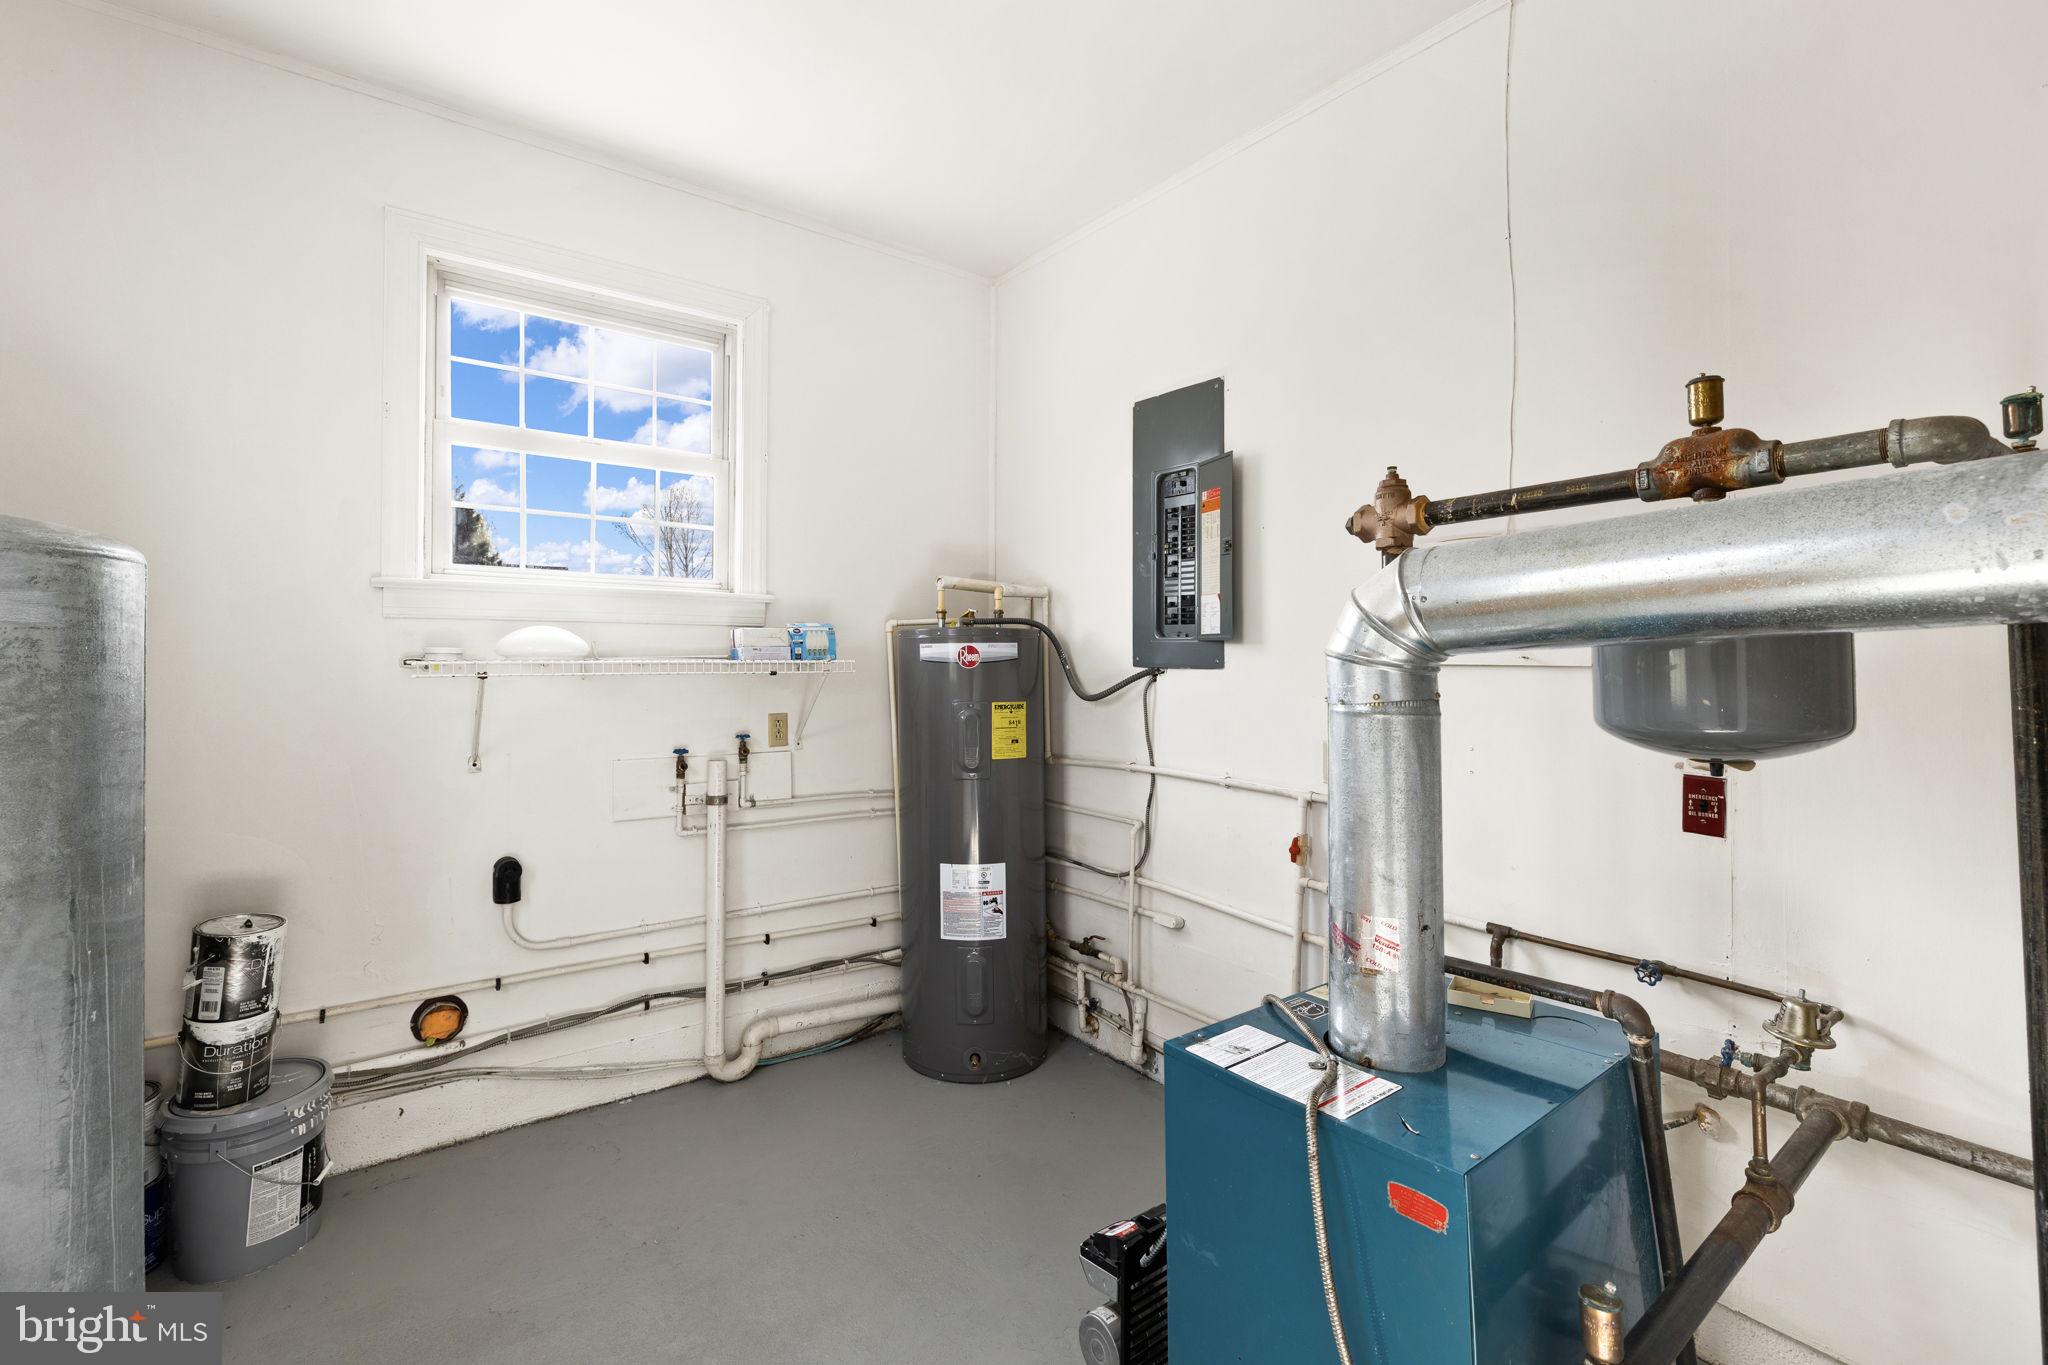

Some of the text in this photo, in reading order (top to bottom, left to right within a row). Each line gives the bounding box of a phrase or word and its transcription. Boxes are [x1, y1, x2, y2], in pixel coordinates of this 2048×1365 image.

[960, 645, 980, 665] Rheem
[1688, 793, 1718, 802] EMERGENCY
[1697, 811, 1719, 819] BURNER
[203, 1036, 269, 1058] Duration
